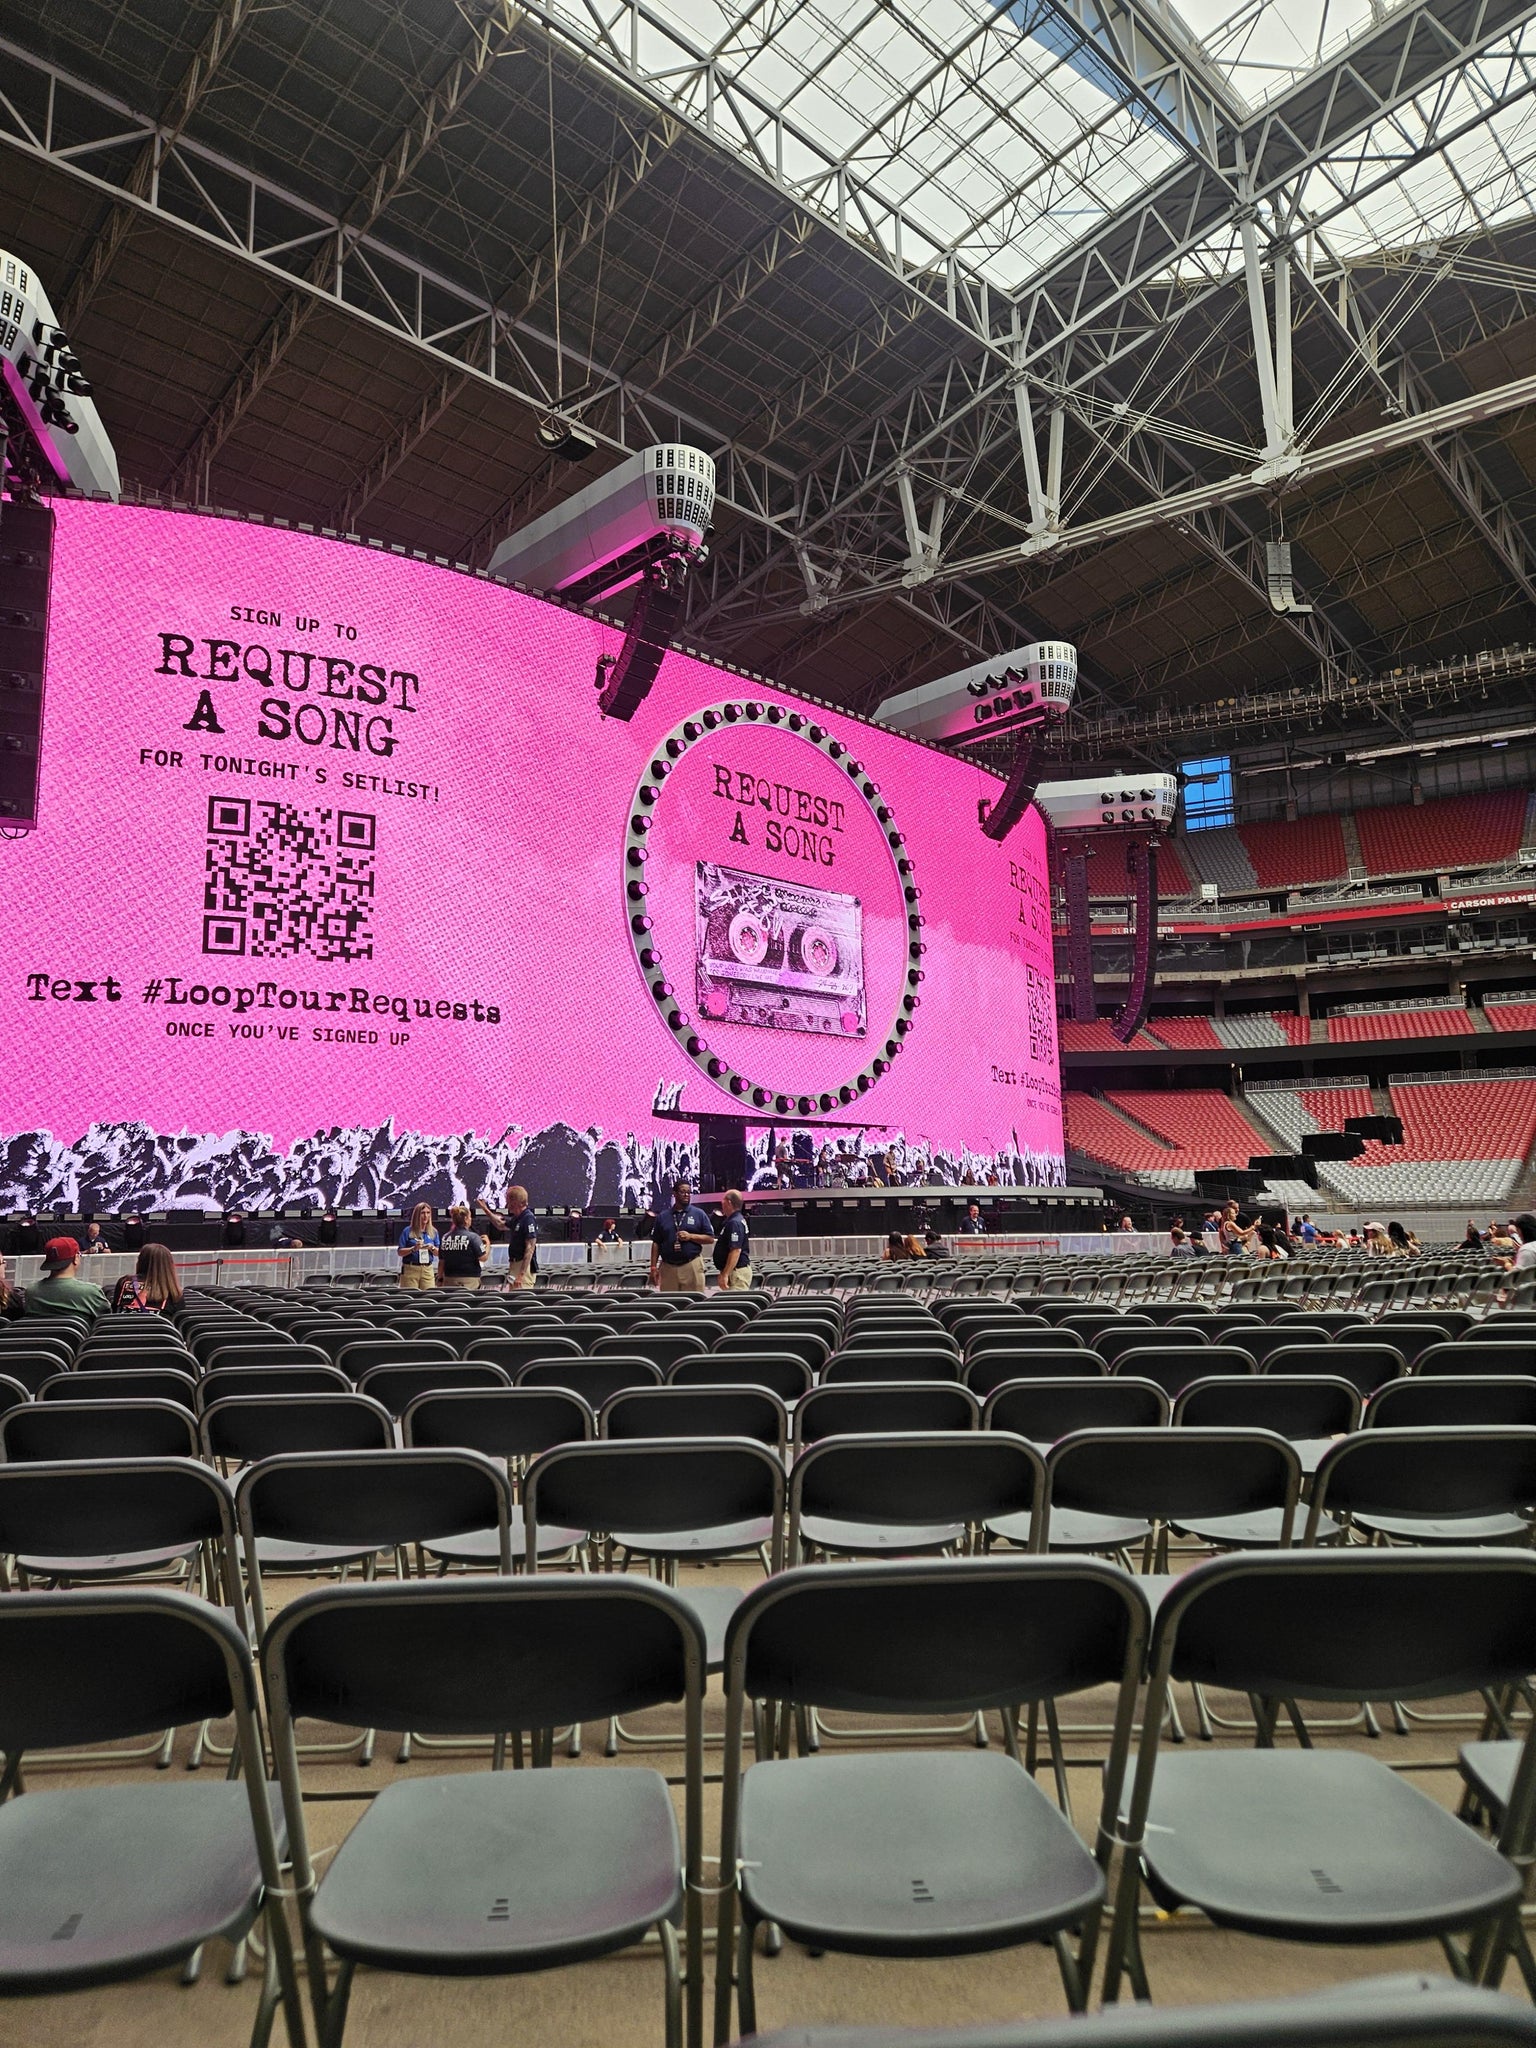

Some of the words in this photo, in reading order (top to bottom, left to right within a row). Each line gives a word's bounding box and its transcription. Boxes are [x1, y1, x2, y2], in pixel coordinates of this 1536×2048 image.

[230, 606, 281, 627] SIGN
[295, 616, 320, 633] UP
[333, 623, 358, 641] TO
[155, 632, 420, 713] REQUEST
[183, 690, 226, 734] A
[258, 698, 400, 757] SONG
[139, 748, 183, 768] FOR
[200, 753, 328, 784] TONIGHT'S
[342, 771, 440, 803] SETLIST!
[713, 764, 845, 834] REQUEST
[729, 811, 750, 845] A
[766, 819, 837, 866] SONG
[1009, 861, 1049, 916] REQUE
[1442, 902, 1449, 911] 3
[1450, 897, 1495, 910] CARSON
[1111, 927, 1121, 935] 81
[27, 973, 122, 1003] Text
[142, 977, 501, 1025] #LoopTourRequests
[166, 1021, 216, 1039] ONCE
[229, 1024, 299, 1041] YOU'VE
[312, 1028, 378, 1045] SIGNED
[390, 1031, 410, 1047] UP
[991, 1065, 1017, 1085] Text
[441, 1240, 470, 1251] ECURITY
